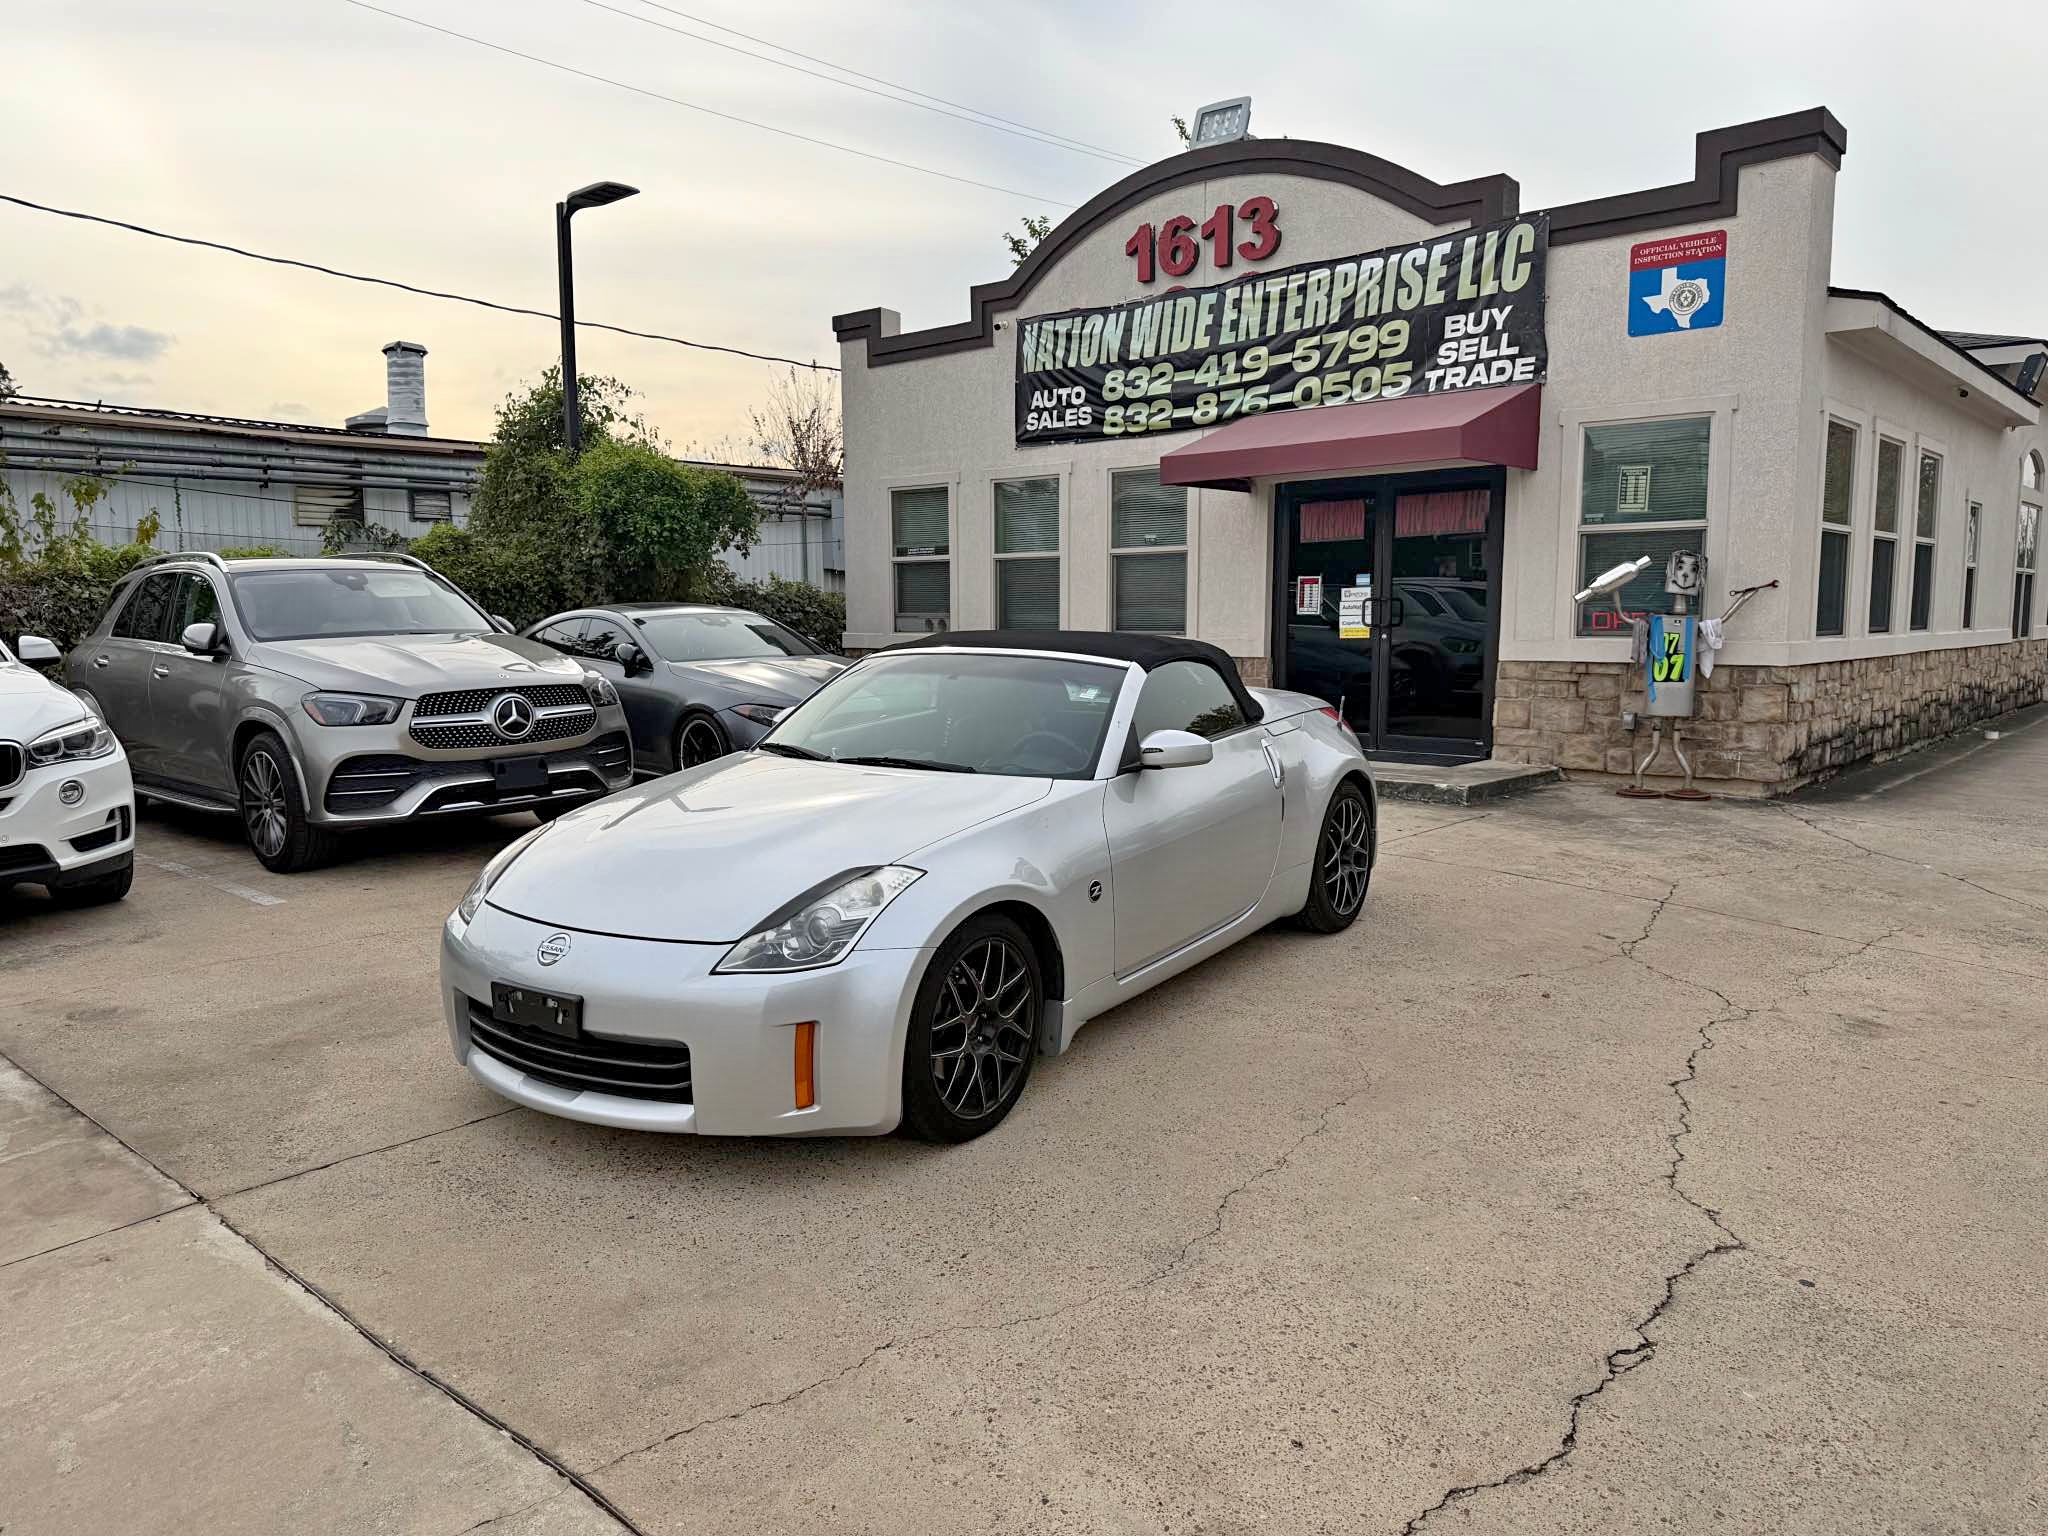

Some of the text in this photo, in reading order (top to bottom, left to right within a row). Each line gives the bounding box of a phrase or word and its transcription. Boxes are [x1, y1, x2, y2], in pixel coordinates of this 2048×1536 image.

[1125, 196, 1282, 284] 1613
[1634, 244, 1722, 265] INSPECTION STATION
[1639, 236, 1717, 256] OFFICIAL VEHICLE
[1022, 223, 1535, 374] NATION WIDE ENTERPRISE LLC
[1444, 304, 1514, 339] BUY
[1101, 319, 1410, 402] 832-419-5799
[1436, 332, 1520, 366] SELL
[1424, 356, 1536, 393] TRADE
[1030, 386, 1087, 410] AUTO
[1102, 360, 1413, 436] 832-876-0505
[1026, 406, 1093, 431] SALES
